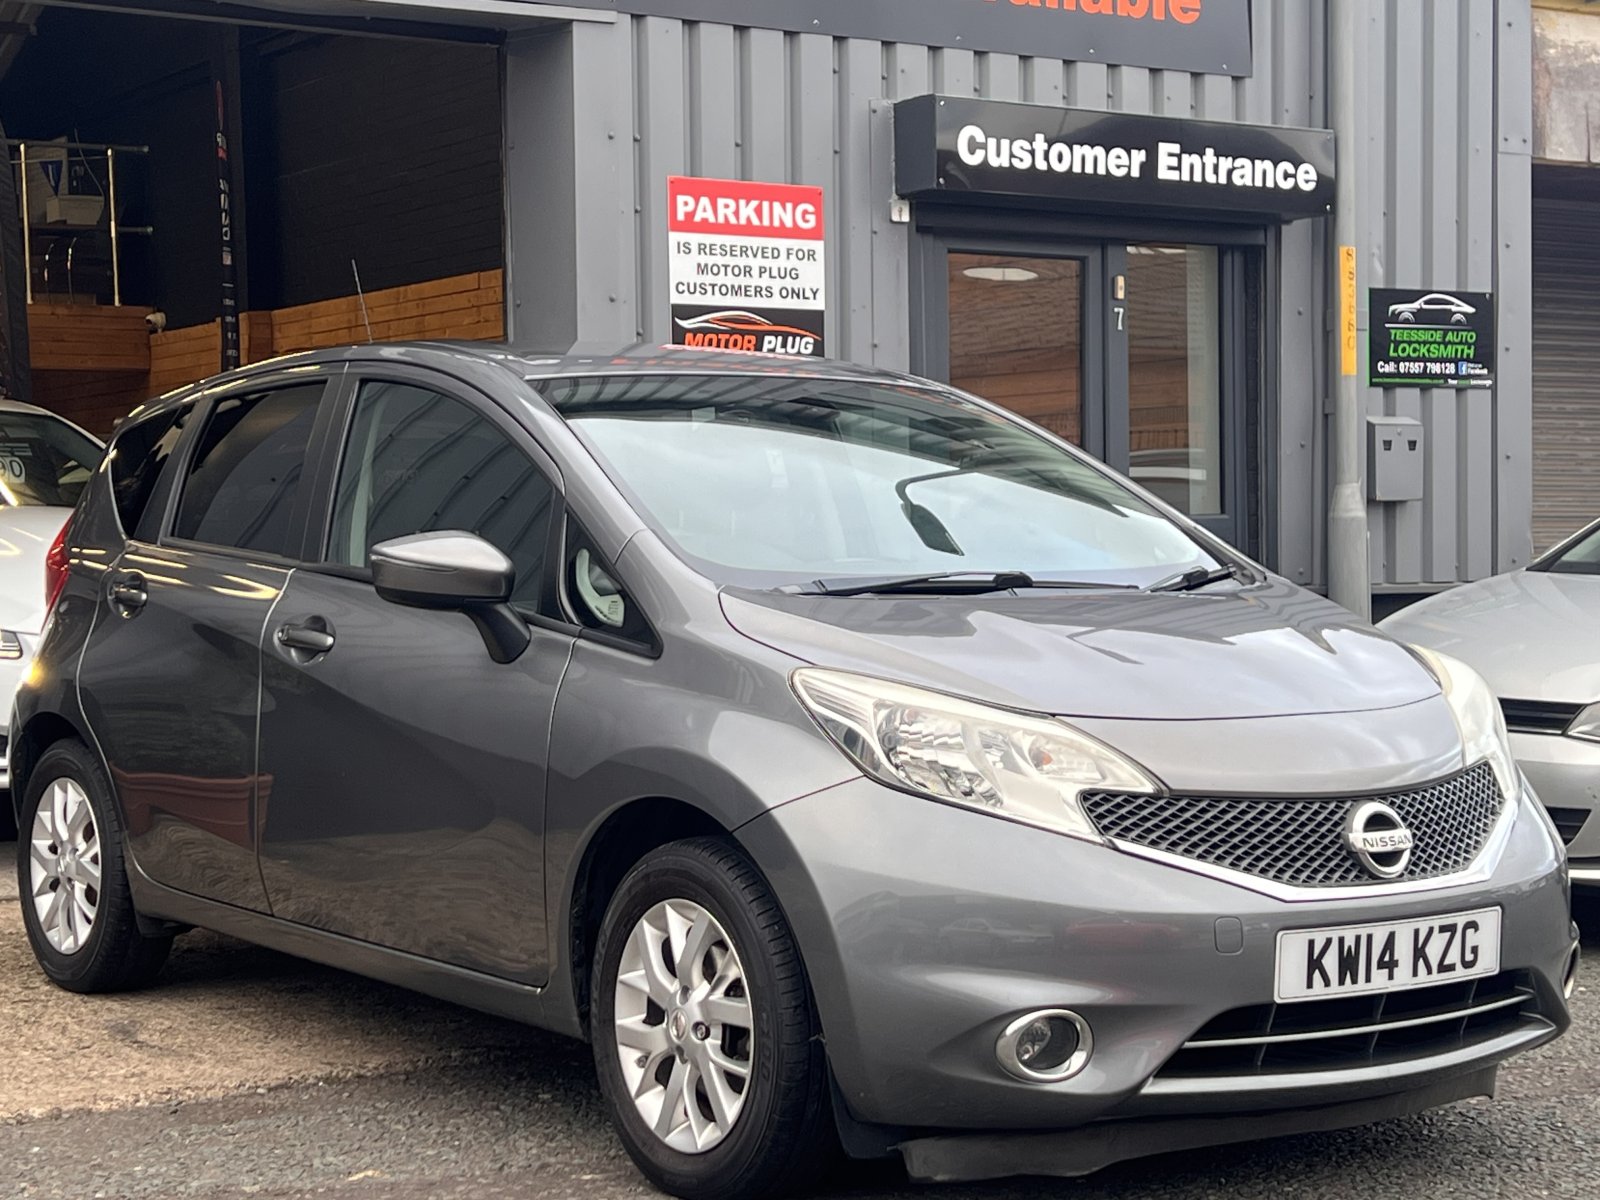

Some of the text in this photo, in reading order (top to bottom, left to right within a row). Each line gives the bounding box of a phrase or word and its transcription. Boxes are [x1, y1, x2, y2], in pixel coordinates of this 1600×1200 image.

[957, 125, 1318, 191] Customer Entrance
[675, 194, 817, 230] PARKING
[677, 241, 817, 262] IS RESERVED FOR
[696, 262, 800, 281] MOTOR PLUG
[675, 281, 820, 301] CUSTOMERS ONLY
[1113, 307, 1124, 331] 7
[684, 332, 814, 354] MOTOR PLUG
[1390, 329, 1476, 343] TEESSIDE AUTO
[1389, 342, 1475, 359] LOCKSMITH
[1377, 360, 1397, 374] Call:
[1362, 834, 1412, 848] NISSAN
[1306, 920, 1480, 990] KW14 KZG
